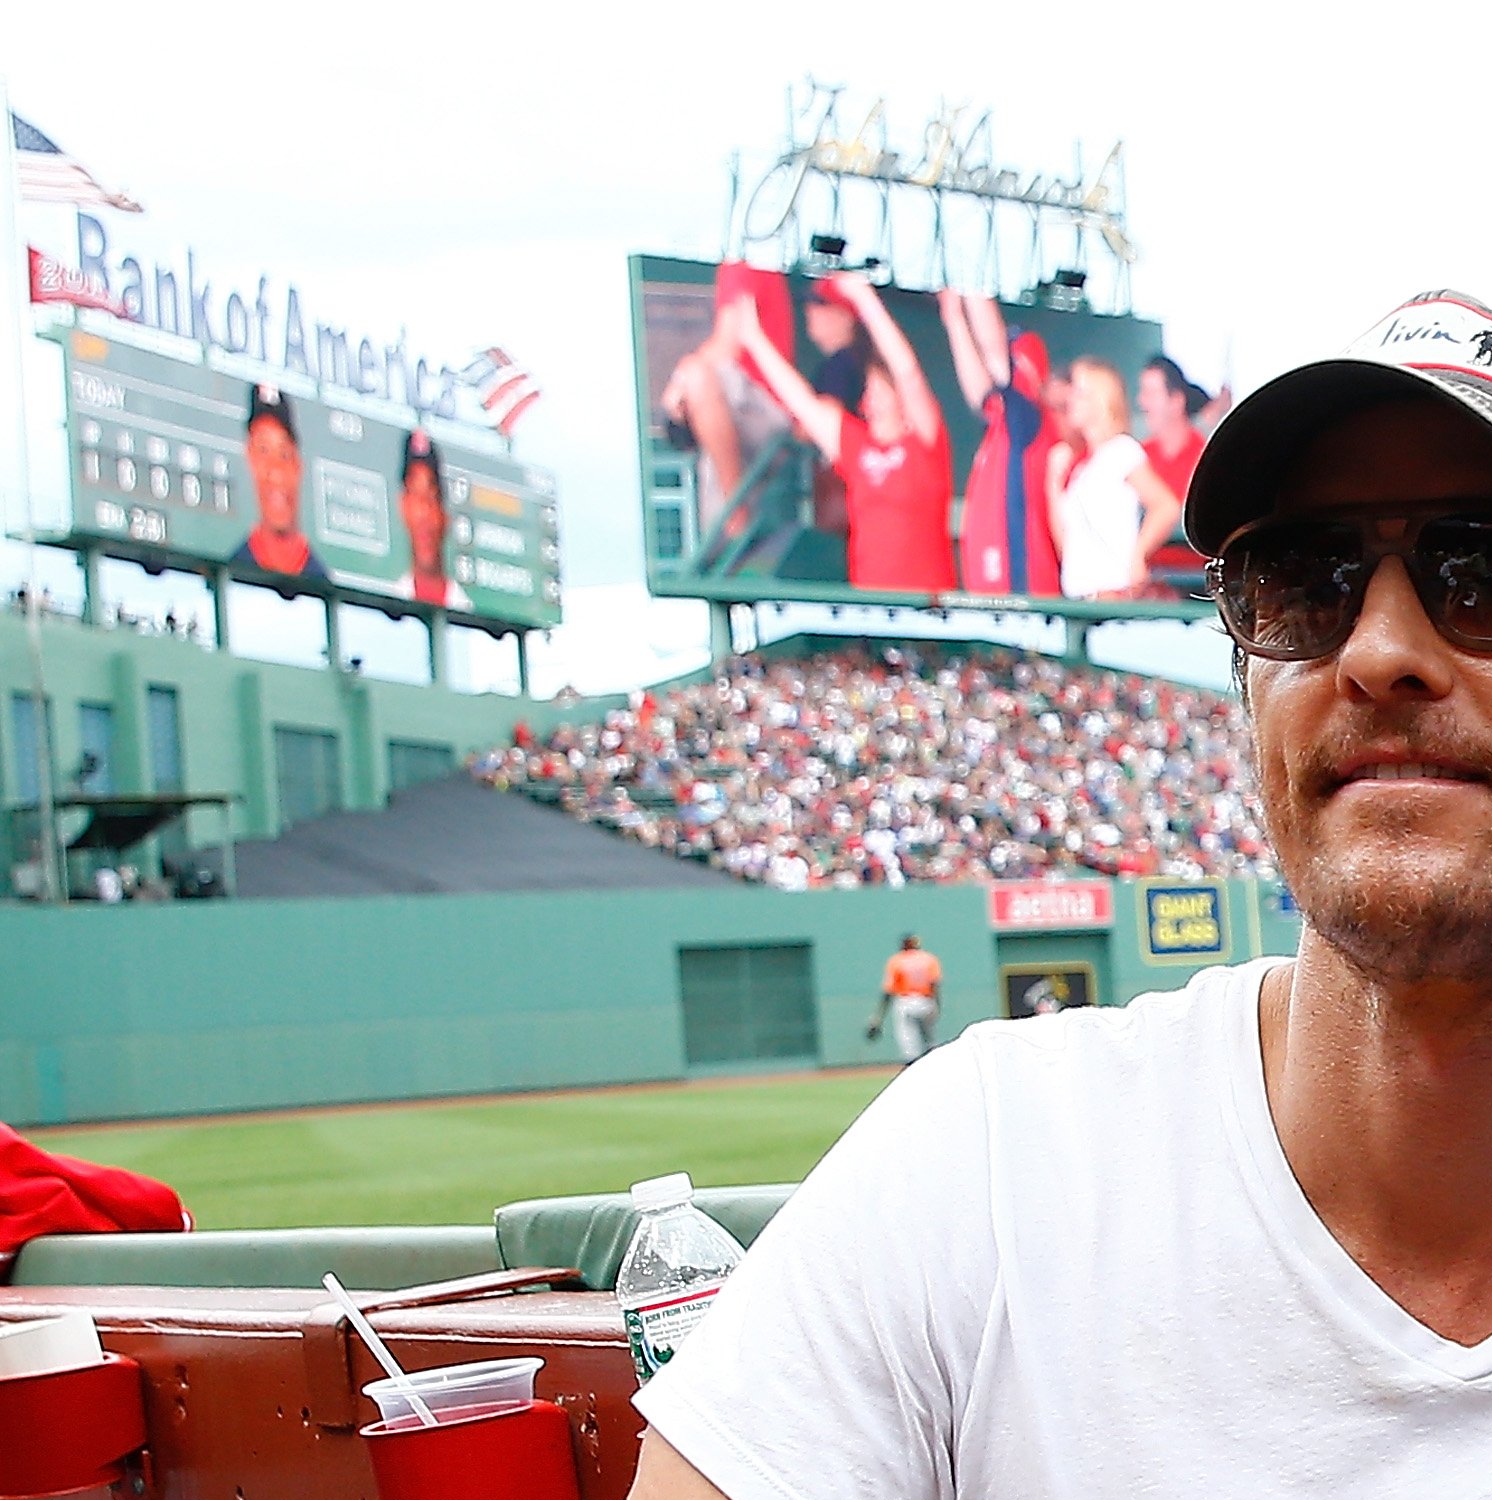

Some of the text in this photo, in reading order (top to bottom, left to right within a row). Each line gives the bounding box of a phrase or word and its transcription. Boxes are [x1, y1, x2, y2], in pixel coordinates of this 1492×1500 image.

[77, 211, 458, 419] Bank of America
